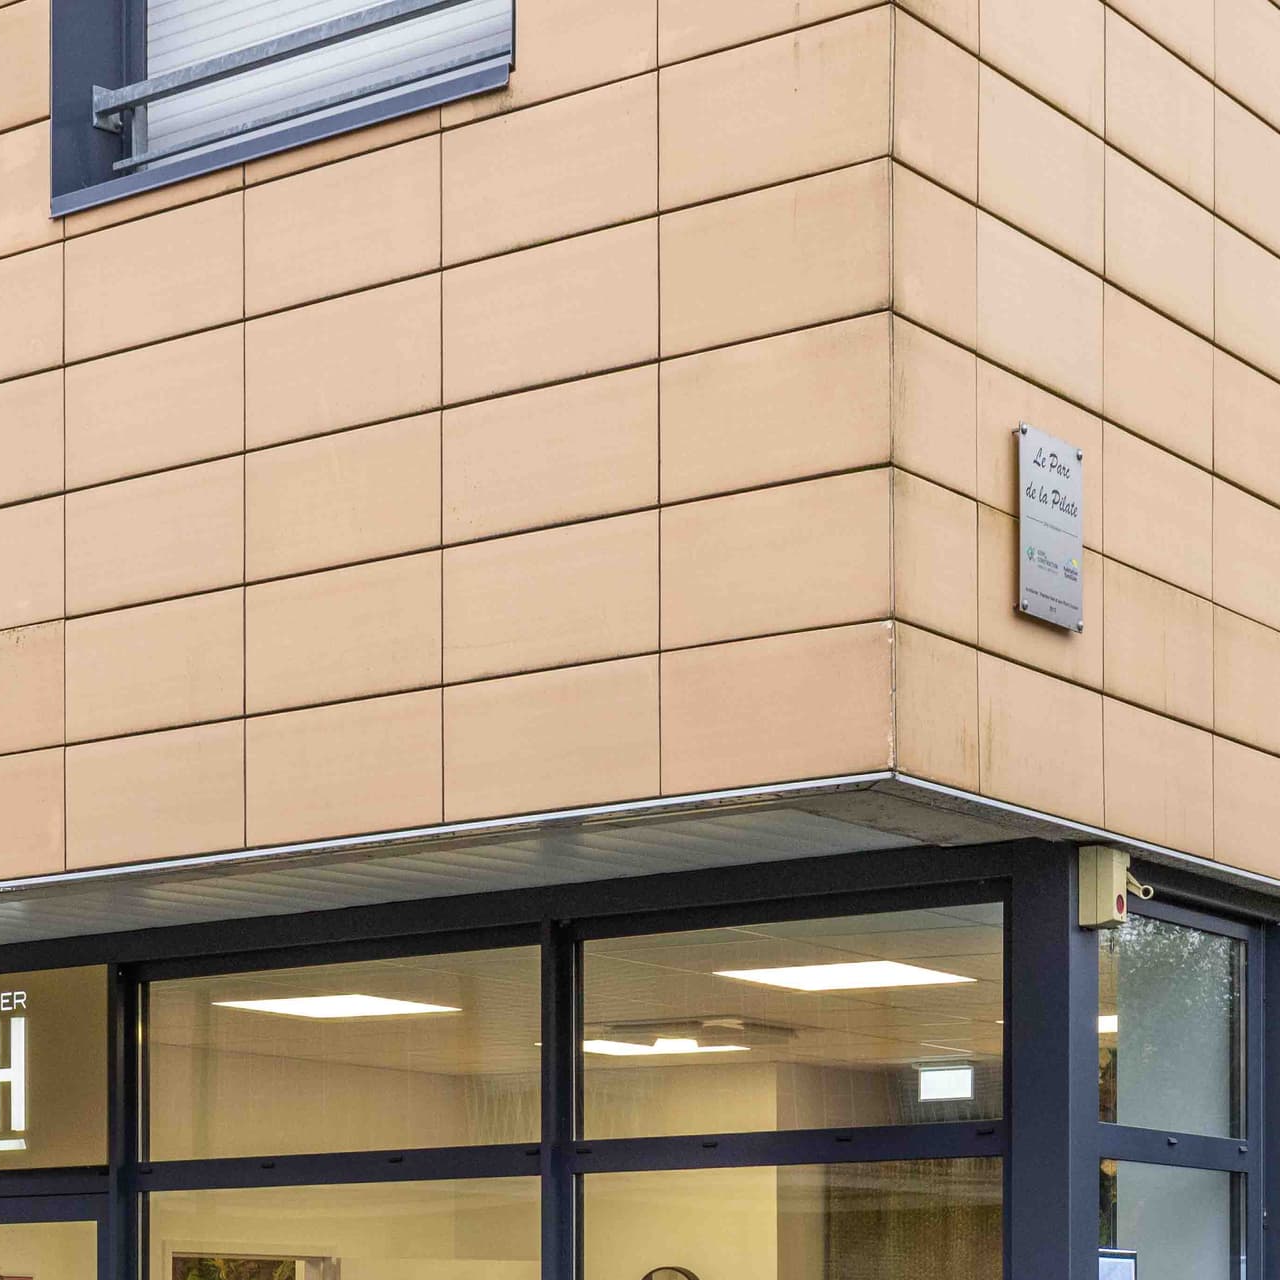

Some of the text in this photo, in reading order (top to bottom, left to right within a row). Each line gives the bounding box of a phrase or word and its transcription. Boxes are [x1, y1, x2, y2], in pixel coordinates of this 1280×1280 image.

[1033, 447, 1071, 479] Le Parc
[1025, 481, 1078, 518] de la Pilate
